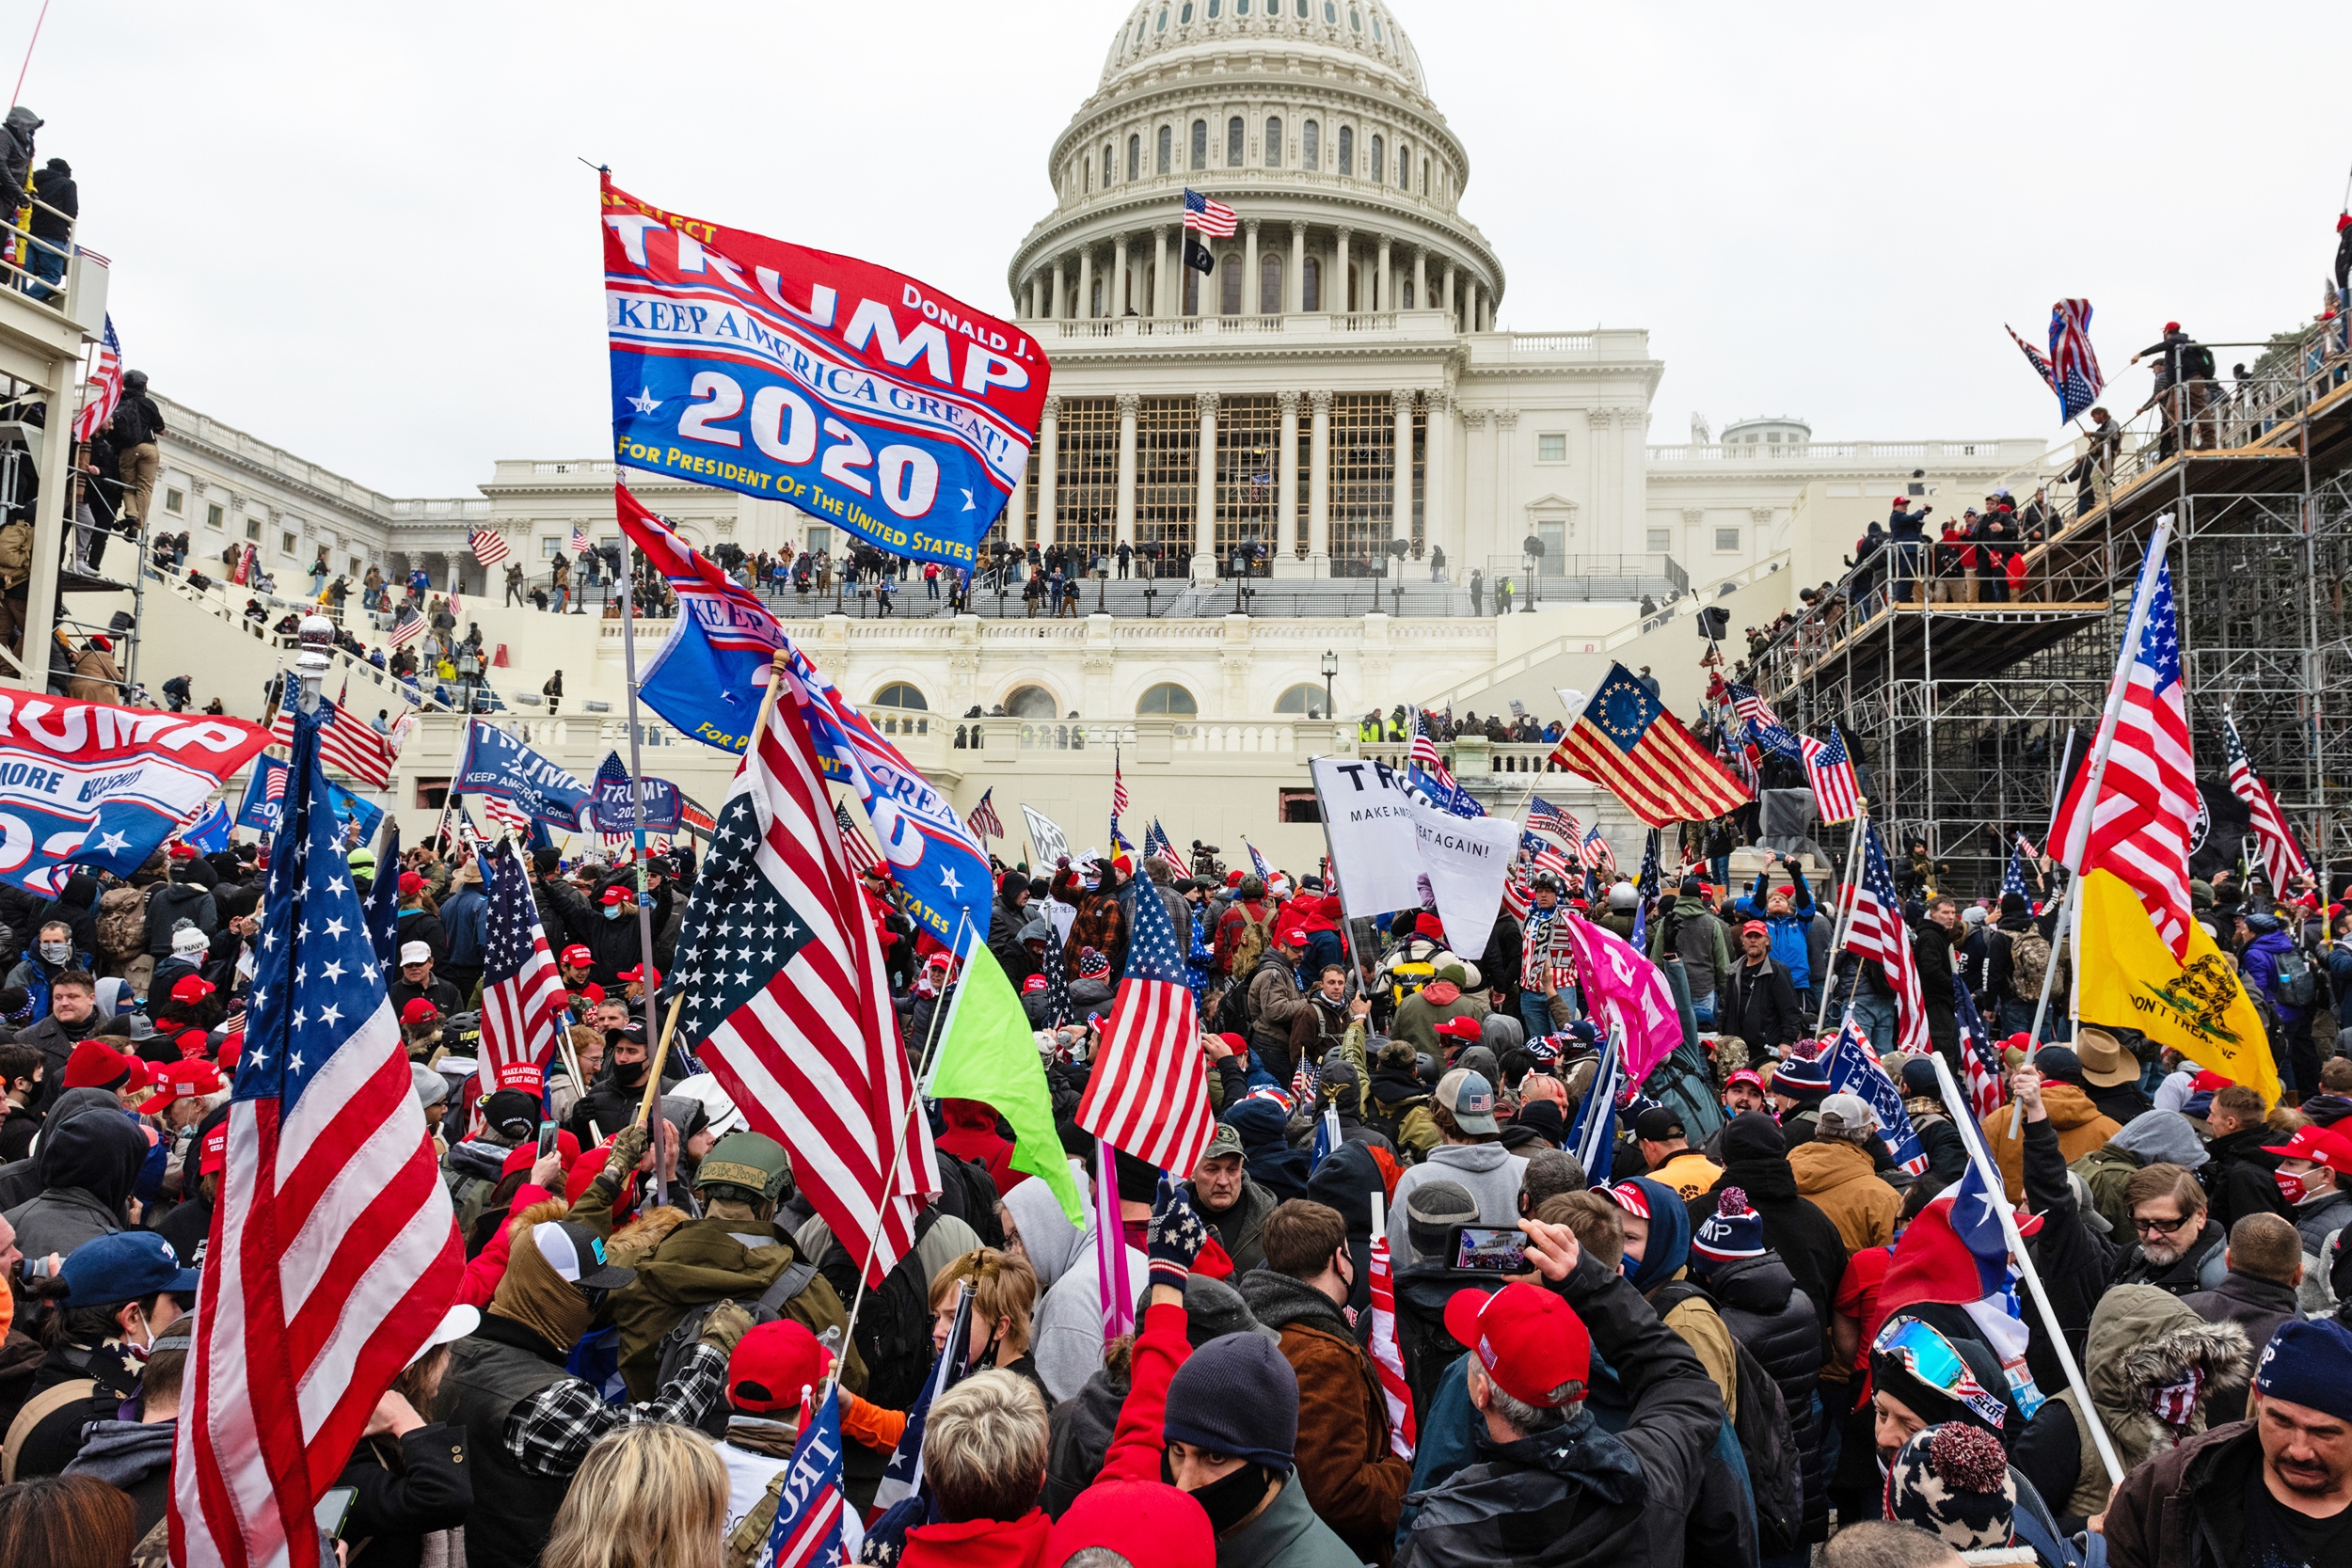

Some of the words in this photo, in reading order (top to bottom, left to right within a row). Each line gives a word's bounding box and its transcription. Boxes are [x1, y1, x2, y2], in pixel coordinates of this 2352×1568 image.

[603, 214, 1031, 395] TRUMP
[901, 282, 1008, 354] DONALD
[1013, 338, 1036, 362] J.
[614, 297, 708, 335] KEEP
[715, 310, 879, 404] AMERICA
[889, 387, 1010, 464] GREAT!
[678, 370, 942, 521] 2020
[617, 435, 661, 465] FOR
[666, 447, 768, 491] PRESIDENT
[776, 475, 807, 499] OF
[812, 484, 845, 518] THE
[846, 501, 909, 547] UNITED
[912, 530, 974, 562] STATES
[683, 595, 764, 634] KEEP
[0, 695, 248, 753] UMP
[695, 721, 735, 748] FOR
[1760, 728, 1801, 751] TRUMP
[466, 772, 497, 784] KEEP
[601, 782, 669, 803] TRUMP
[1025, 812, 1069, 853] INFO
[1351, 806, 1391, 823] MAKE
[1435, 832, 1489, 859] AGAIN!
[1538, 820, 1573, 842] TRUMP
[184, 942, 204, 952] NAVY
[2172, 1011, 2214, 1045] TREA
[501, 1067, 519, 1076] MAKE
[518, 1066, 542, 1076] AMERICA
[503, 1075, 523, 1085] GREAT
[523, 1075, 539, 1085] AGAIN
[728, 1164, 766, 1185] People
